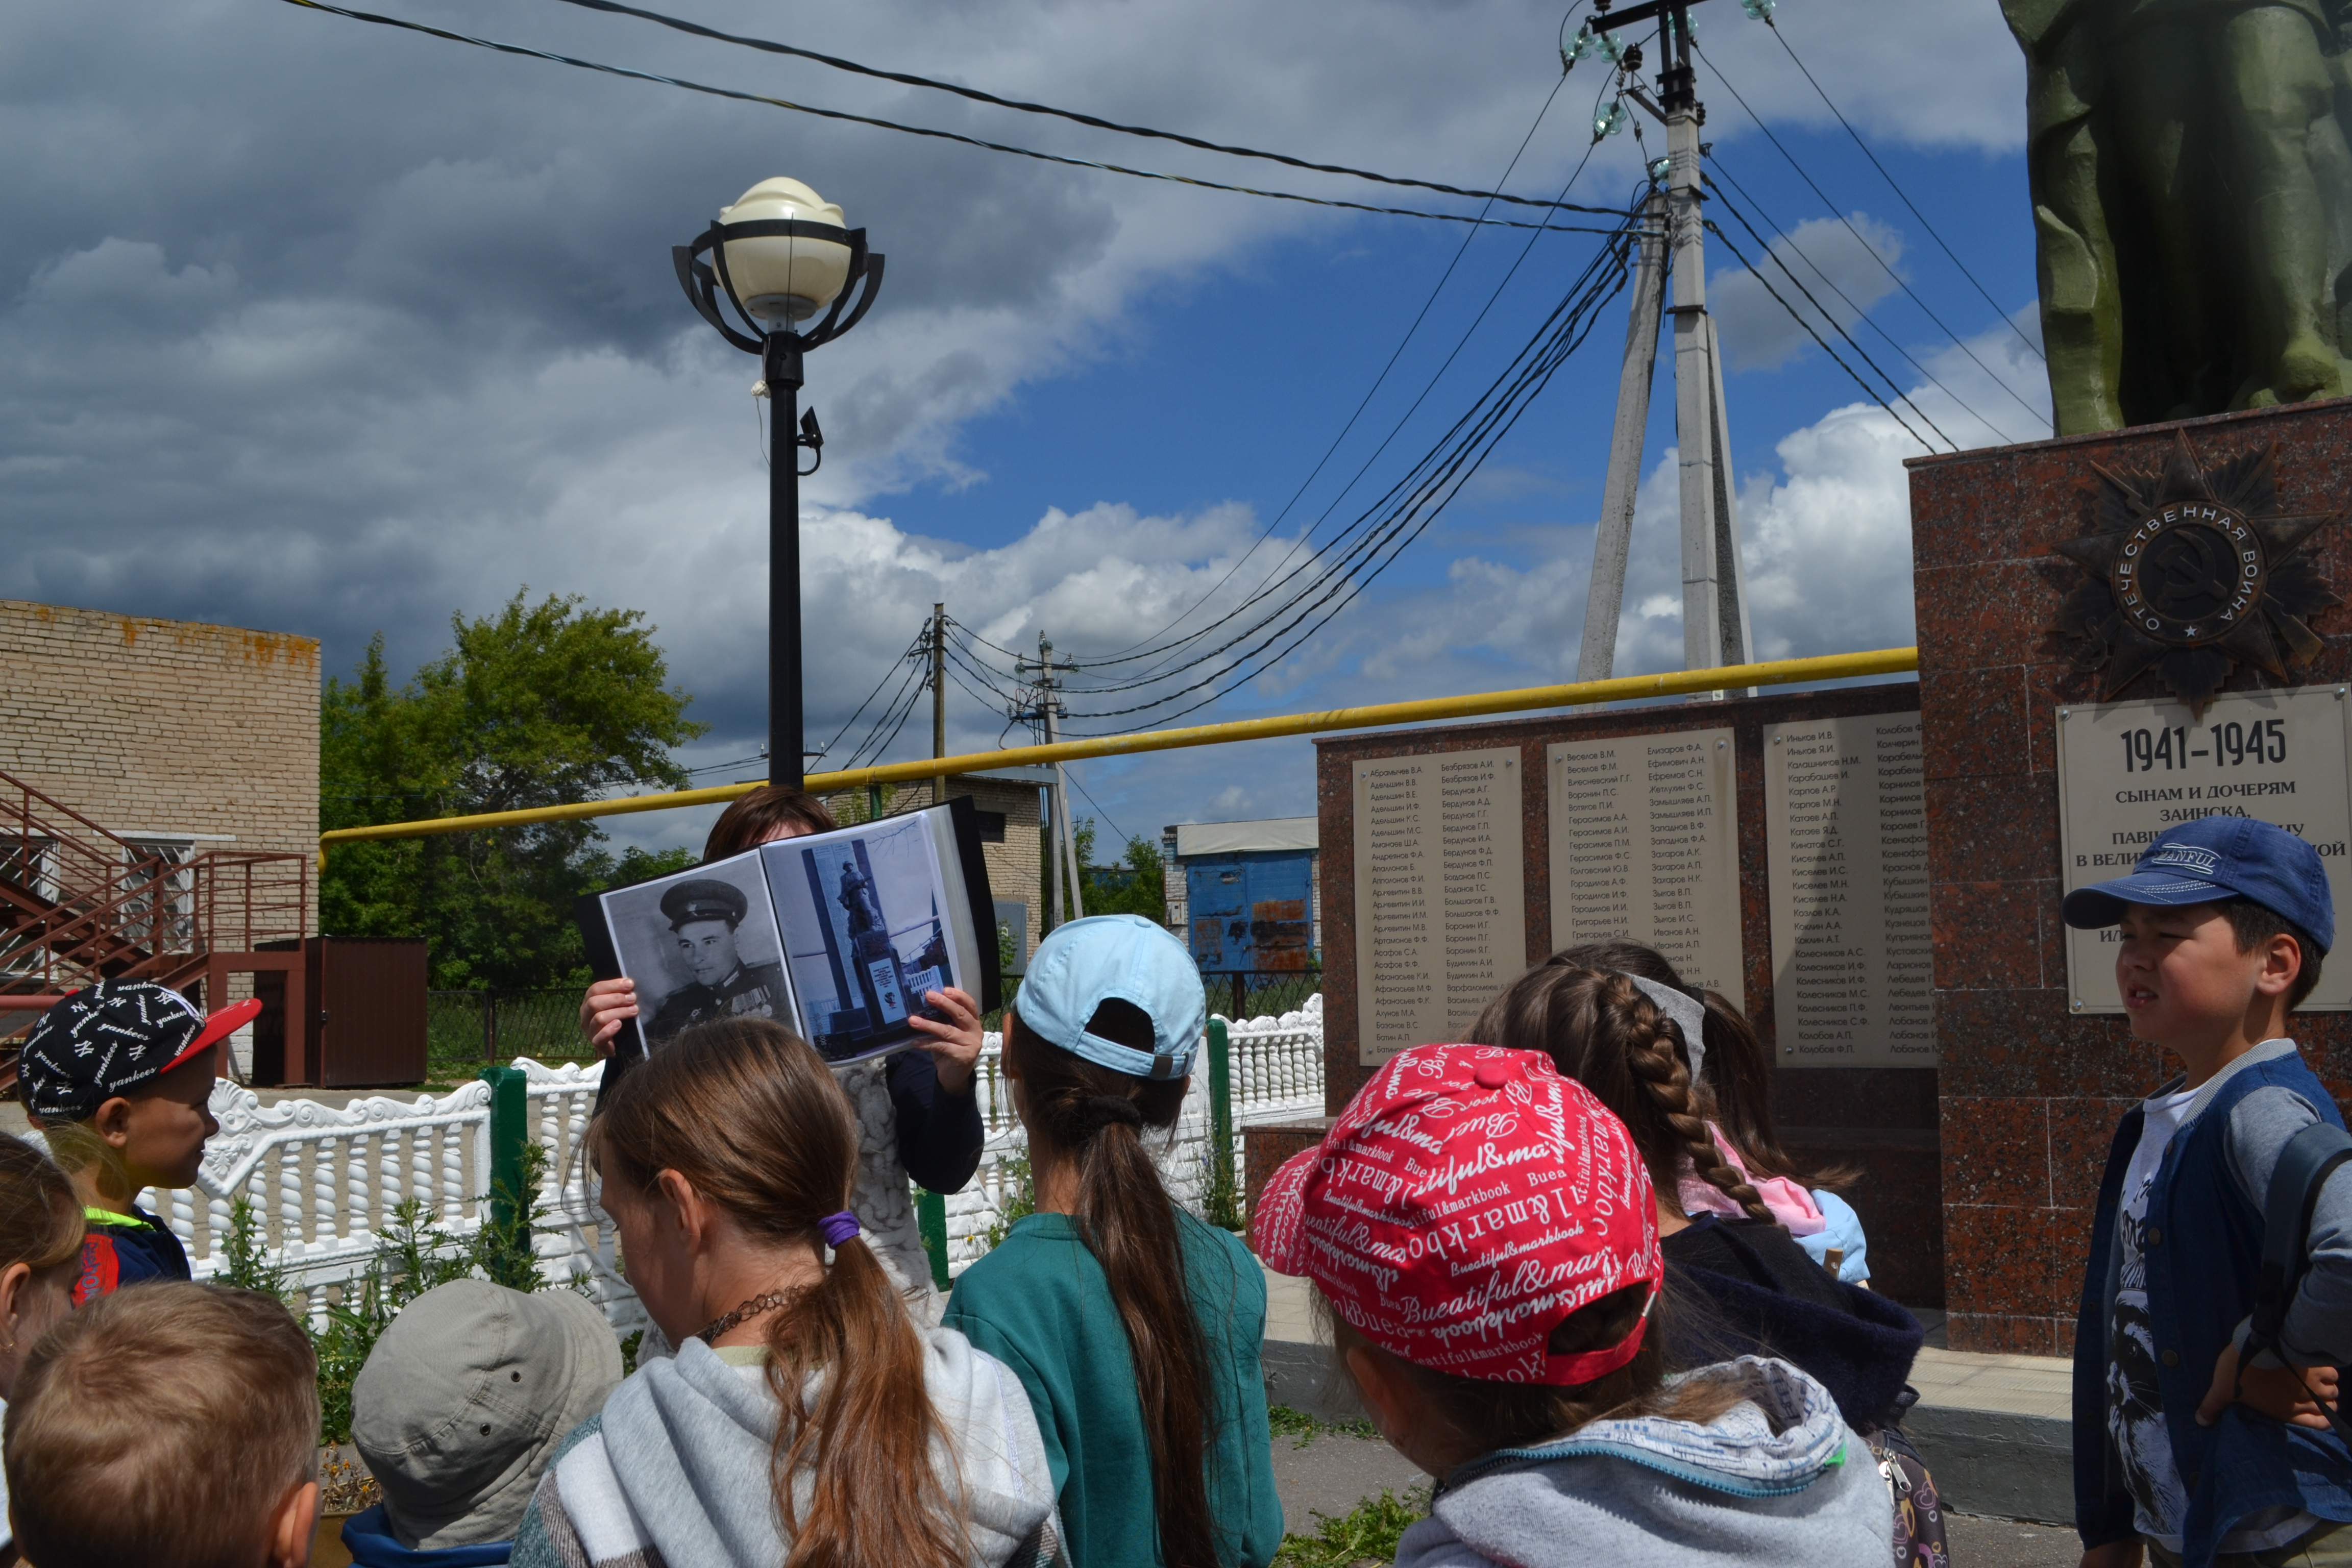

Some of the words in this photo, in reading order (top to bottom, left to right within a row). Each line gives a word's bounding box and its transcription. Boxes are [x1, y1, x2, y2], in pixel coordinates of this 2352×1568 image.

[2119, 507, 2246, 630] ОТЕЧЕСТВЕННАЯ
[1819, 731, 1834, 740] И.В.
[1877, 740, 1919, 749] Колчерин
[1600, 750, 1615, 758] В.М.
[1648, 746, 1684, 755] Елизаров
[1787, 760, 1839, 769] Калашников
[1842, 756, 1860, 765] Н.М.
[1441, 763, 1478, 772] Безбрязов
[1370, 769, 1409, 778] Абрамычев
[1649, 772, 1685, 781] Ефремов
[1688, 769, 1704, 777] С.Н.
[1568, 776, 1618, 786] Вжесневский
[1442, 788, 1475, 797] Бердунов
[1477, 785, 1489, 793] А.Г.
[1789, 788, 1820, 797] Карпов
[2116, 787, 2183, 803] СЫНАМ
[2189, 786, 2201, 800] И
[2207, 781, 2296, 800] ДОЧЕРЯМ
[1649, 798, 1694, 806] Замышляев
[1697, 795, 1711, 803] А.П.
[1442, 813, 1475, 821] Бердунов
[1822, 812, 1839, 820] А.П.
[1569, 829, 1611, 838] Герасимов
[1443, 837, 1476, 845] Бердунов
[1828, 839, 1844, 848] С.Г.
[1571, 854, 1613, 863] Герасимов
[1651, 850, 1684, 859] Захаров
[2076, 855, 2088, 867] В
[1829, 866, 1848, 874] И.С.
[1571, 880, 1609, 889] Городилов
[1652, 876, 1685, 885] Захаров
[1883, 877, 1927, 889] Кубышкин
[1373, 890, 1410, 898] Аржевитин
[1831, 894, 1848, 902] Н.А.
[1884, 890, 1928, 901] Кубышкин
[1572, 905, 1610, 914] Городилов
[1653, 902, 1676, 911] Зыков
[1884, 905, 1927, 915] Кудряшов
[1795, 922, 1823, 930] Коклин
[1826, 921, 1842, 929] А.А.
[1573, 931, 1611, 940] Григорьев
[1614, 929, 1630, 939] С.И.
[1685, 927, 1700, 935] А.Н.
[1374, 938, 1412, 946] Артамонов
[1446, 935, 1476, 943] Боронин
[1886, 934, 1932, 943] Куприянов
[1795, 949, 1845, 958] Колесников
[1847, 948, 1866, 956] А.С.
[1375, 961, 1402, 969] Асафов
[1447, 960, 1478, 968] Будилкин
[1886, 961, 1931, 971] Ларионов
[1375, 985, 1415, 994] Афанасьев
[1797, 991, 1846, 999] Колесников
[1849, 989, 1869, 997] М.С.
[1798, 1004, 1848, 1012] Колесников
[70, 1002, 105, 1038] yankees
[156, 1009, 188, 1028] yankees
[97, 1022, 151, 1041] yankees
[1799, 1045, 1834, 1055] Колобов
[34, 1050, 73, 1079] yankees
[94, 1040, 118, 1088] yankees
[109, 1066, 157, 1093] yankees
[38, 1104, 83, 1114] yankees
[1451, 1220, 1584, 1277] Bueatiful&markbook
